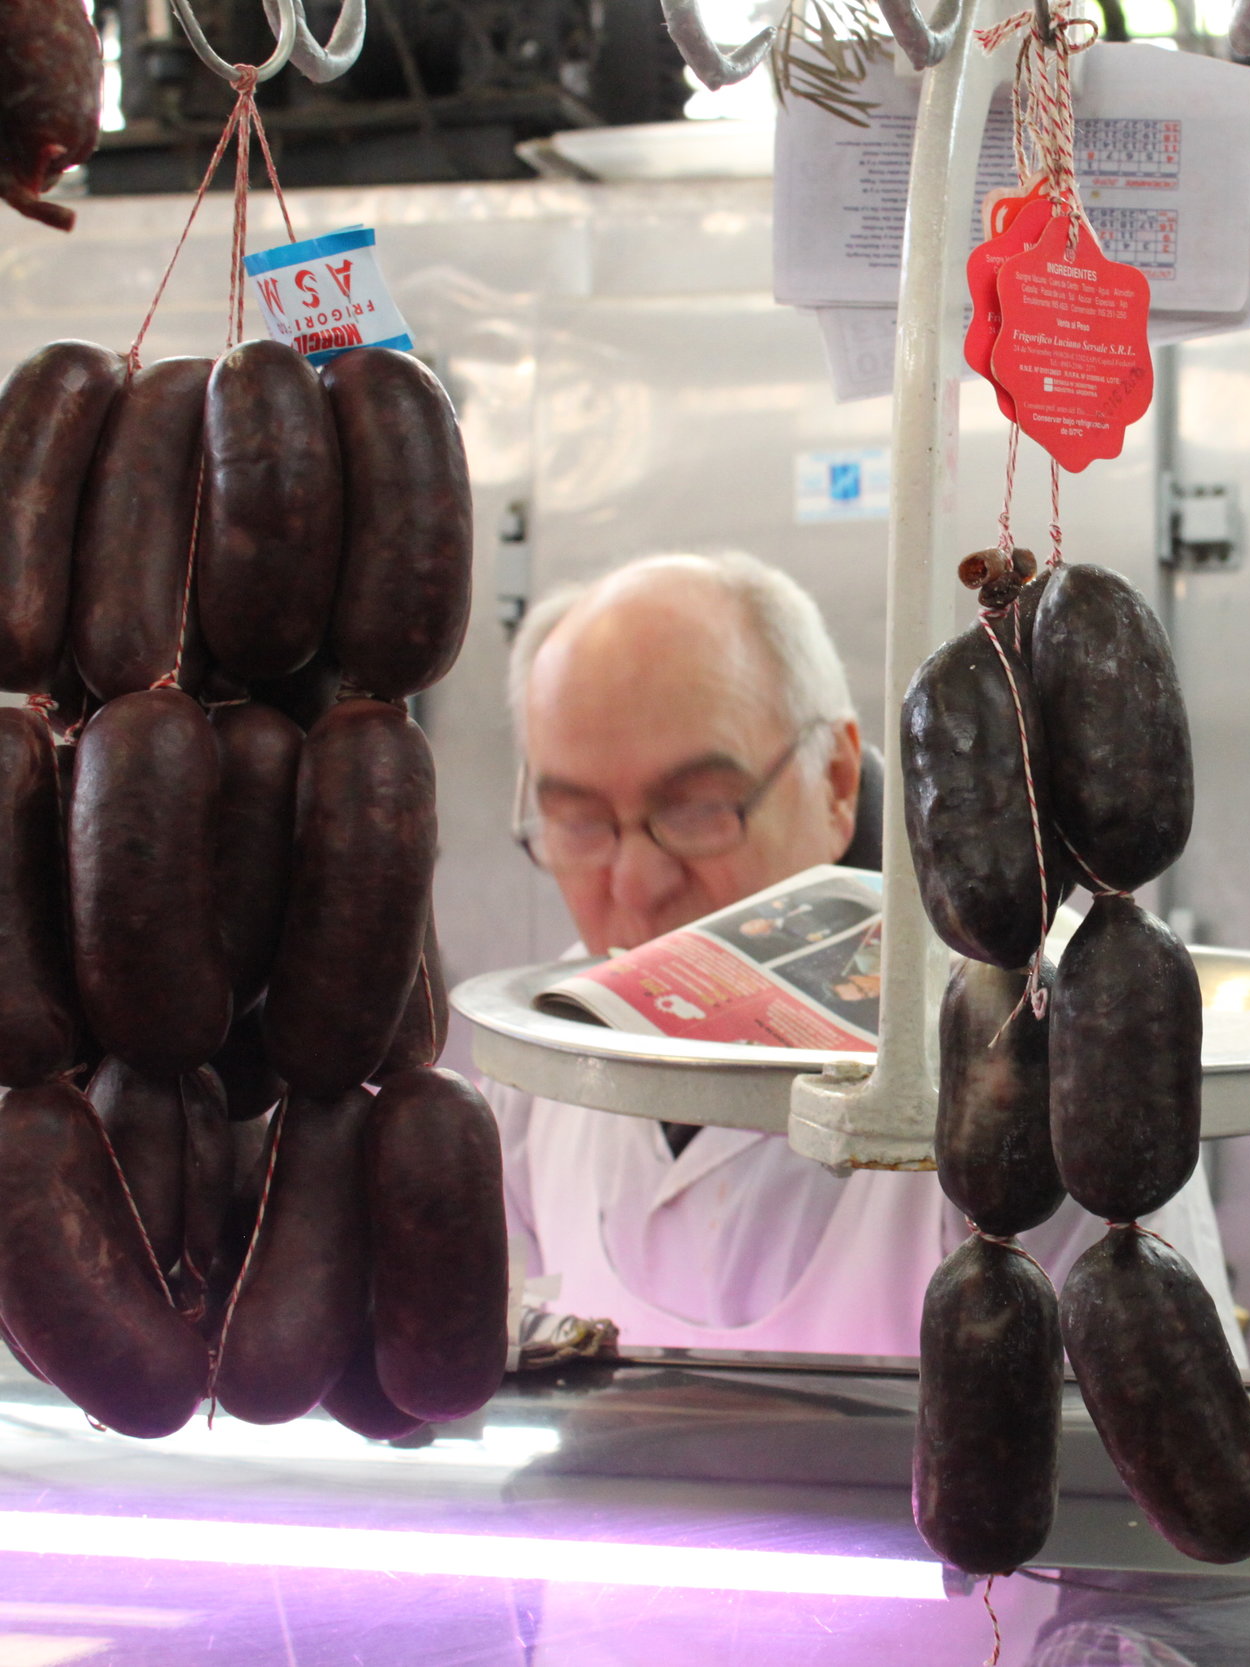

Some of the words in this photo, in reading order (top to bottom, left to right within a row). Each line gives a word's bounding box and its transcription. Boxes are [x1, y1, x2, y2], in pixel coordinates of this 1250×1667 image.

[1047, 262, 1097, 281] INGREDIENTES
[1054, 336, 1081, 349] Luciano
[1082, 340, 1108, 353] Sersale
[1109, 345, 1136, 356] S.R.L.
